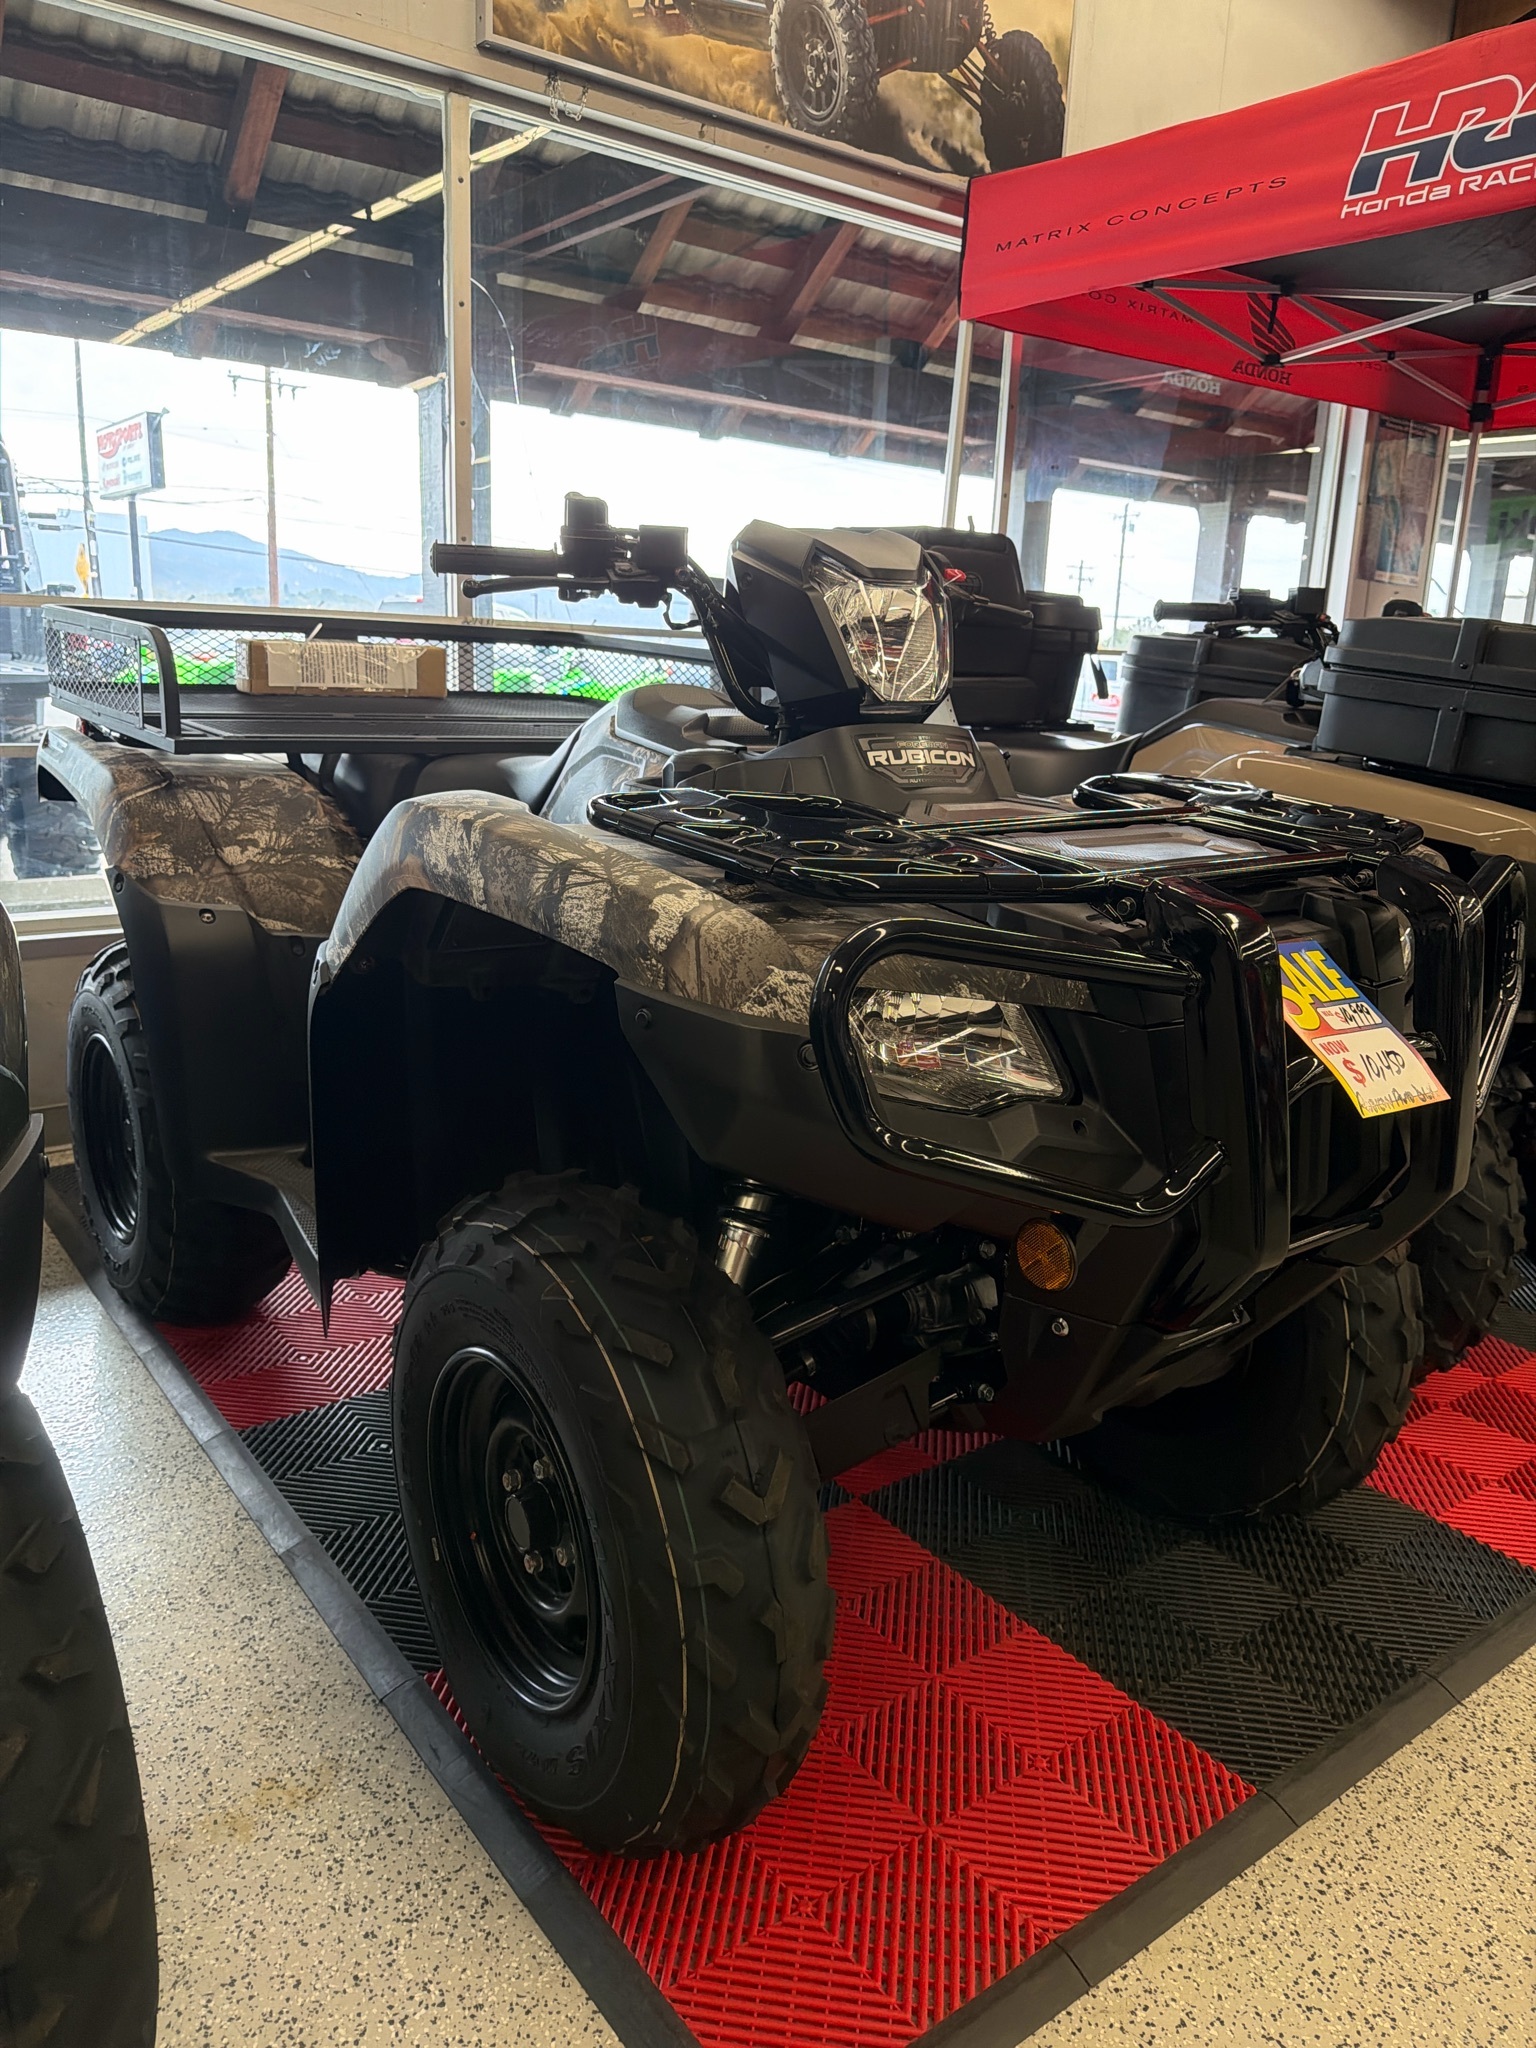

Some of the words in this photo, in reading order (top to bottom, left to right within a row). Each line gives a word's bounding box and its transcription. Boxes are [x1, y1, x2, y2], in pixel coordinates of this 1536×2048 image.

[995, 222, 1091, 252] MATRIX
[1106, 176, 1287, 226] CONCEPTS
[1340, 185, 1451, 219] Honda
[1458, 163, 1536, 195] RAC
[866, 749, 976, 768] RUBICON
[1279, 949, 1360, 1030] SALE
[1319, 1040, 1350, 1056] NOW
